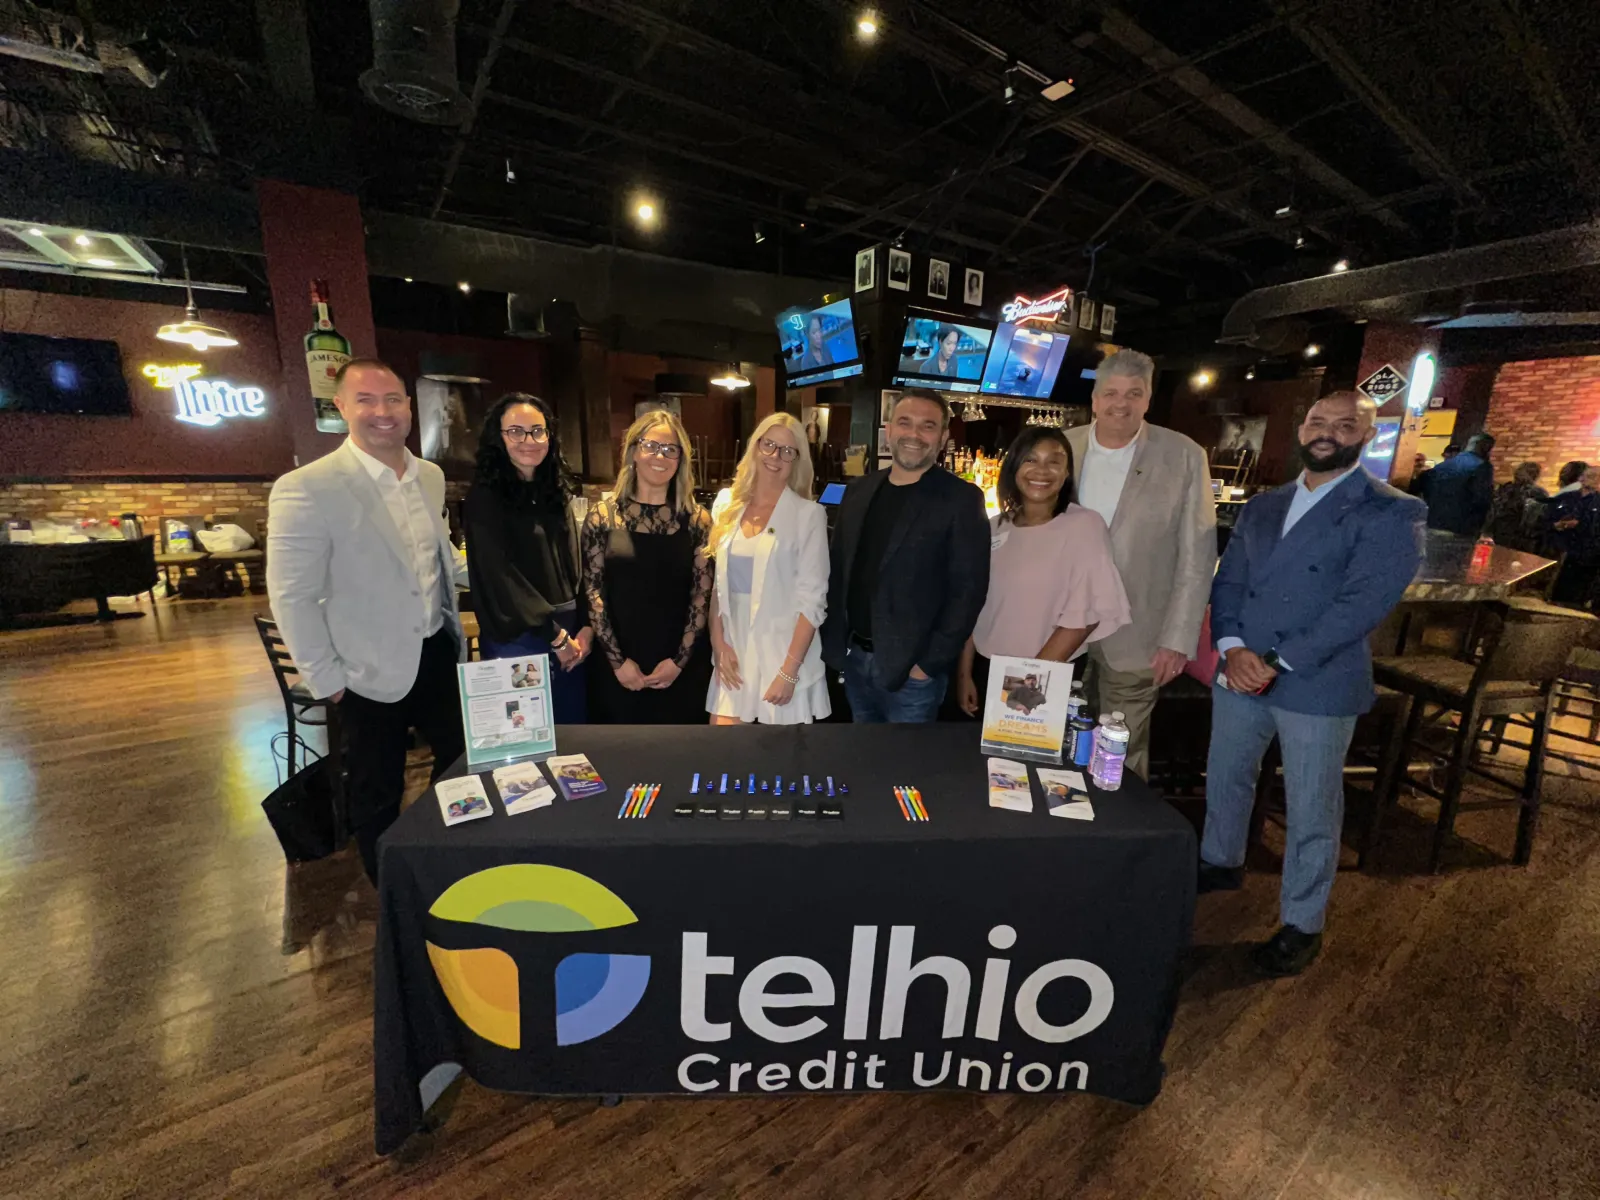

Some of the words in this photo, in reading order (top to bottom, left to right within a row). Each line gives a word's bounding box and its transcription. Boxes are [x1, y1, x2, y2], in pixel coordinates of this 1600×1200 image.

[1367, 383, 1398, 391] RIDGE
[999, 719, 1048, 733] DREAMS
[1016, 715, 1045, 723] FINANCE
[680, 925, 1115, 1043] telhio
[678, 1051, 885, 1091] Credit
[913, 1050, 1089, 1091] Union
